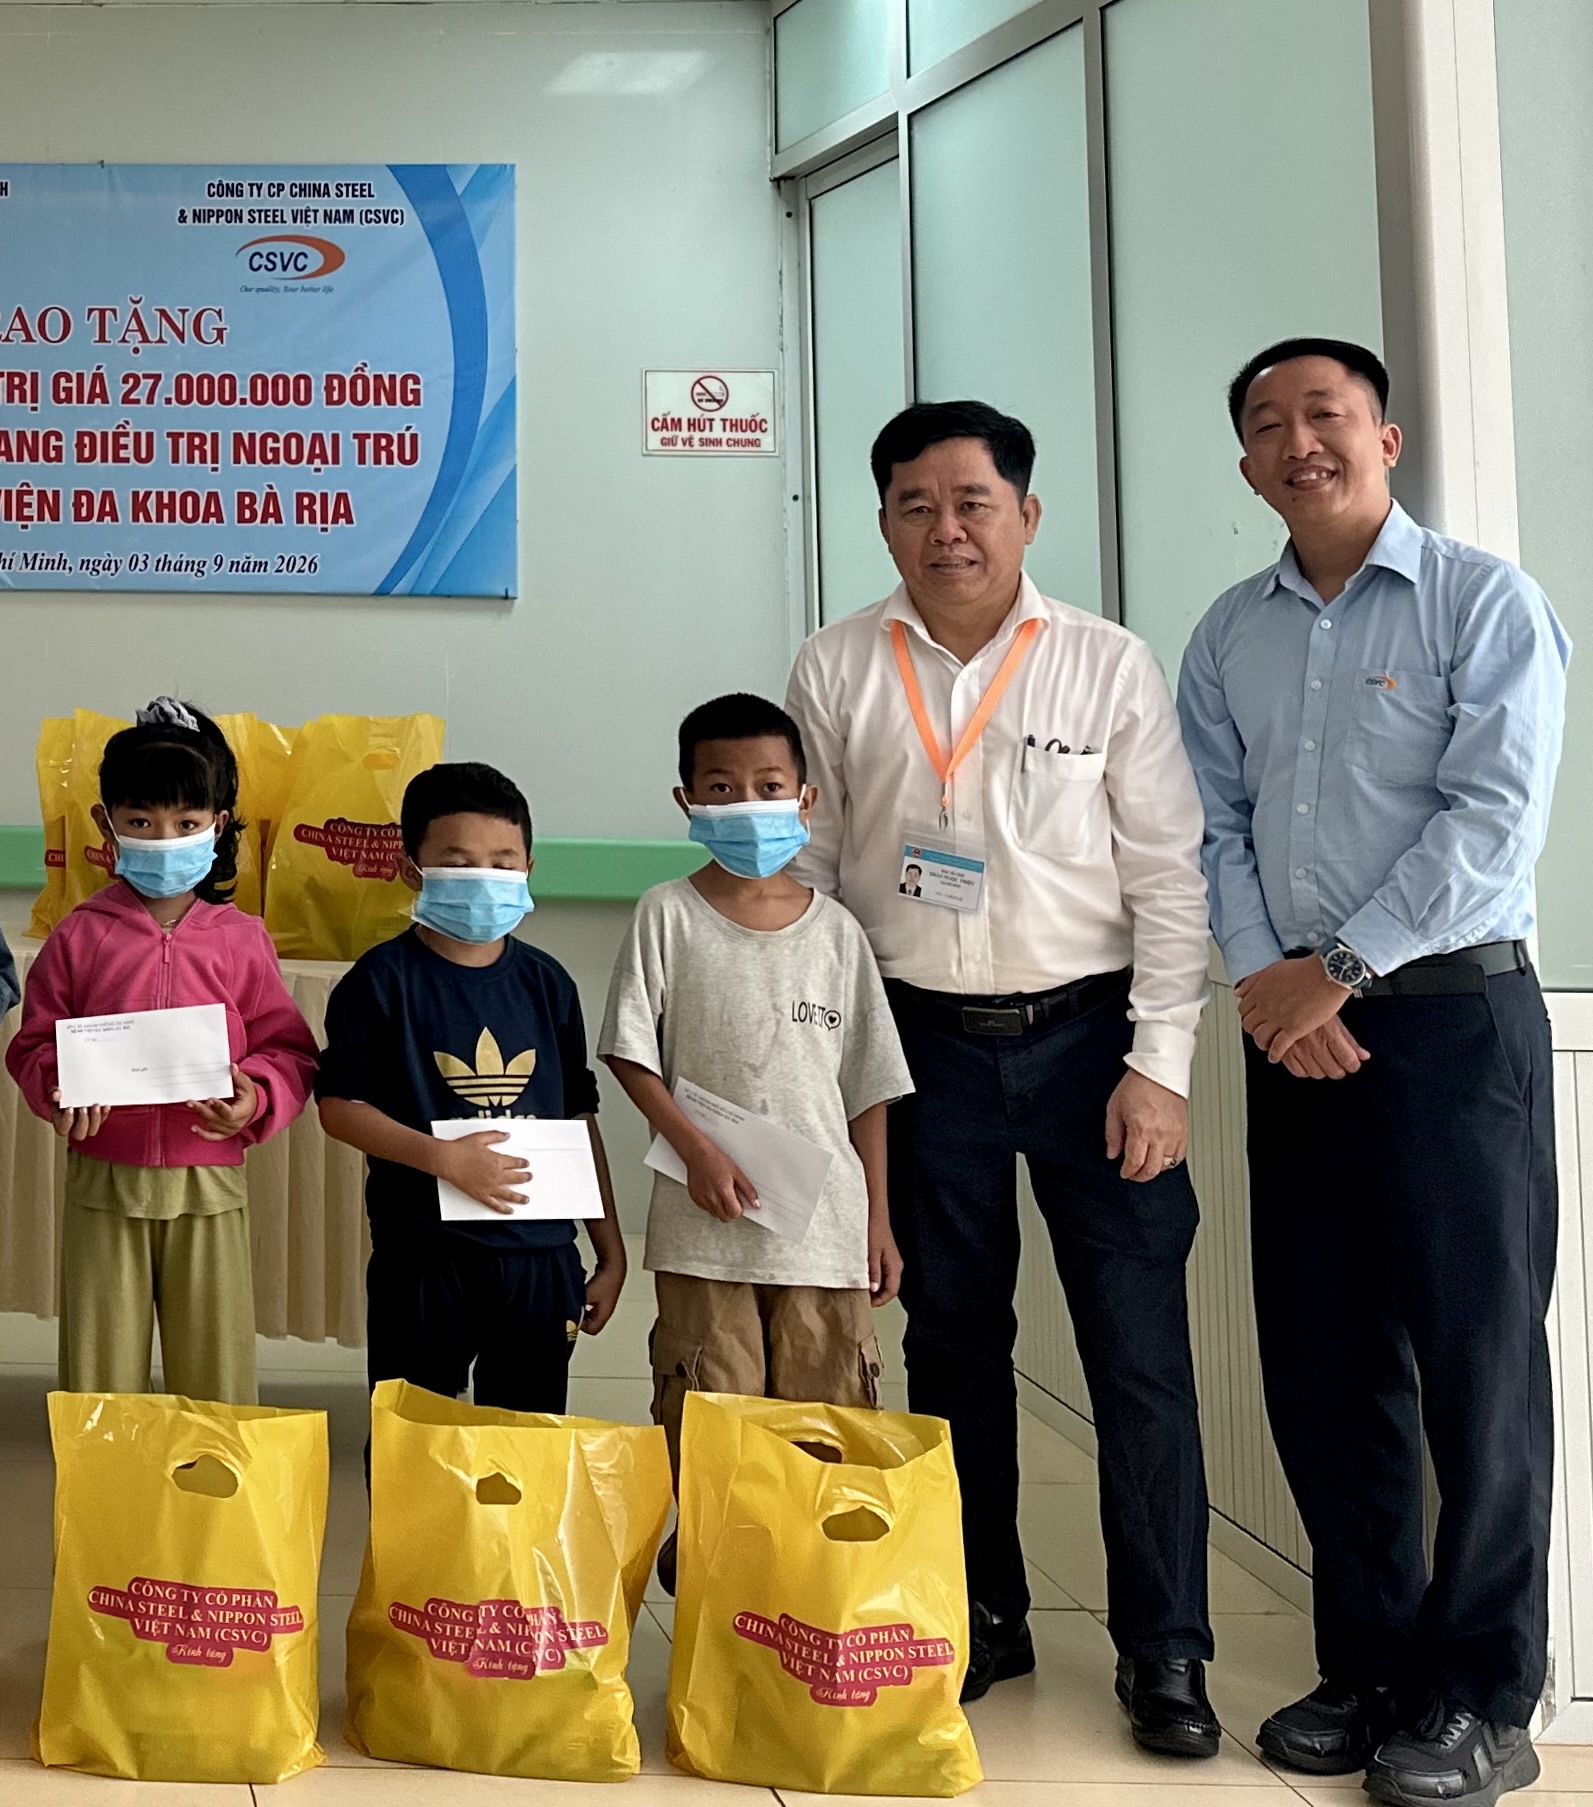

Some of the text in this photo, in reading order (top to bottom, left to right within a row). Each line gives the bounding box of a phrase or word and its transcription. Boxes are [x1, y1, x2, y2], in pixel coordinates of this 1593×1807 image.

[207, 179, 375, 198] CÔNG TY CP CHINA STEEL
[178, 206, 405, 227] & NIPPON STEEL VIỆT NAM (CSVC)
[248, 251, 309, 272] CSVC
[87, 296, 228, 355] TẶNG
[52, 365, 110, 404] GIÁ
[121, 373, 313, 405] 27.000.000
[323, 361, 421, 406] ĐỒNG
[651, 411, 768, 433] CẤM HÚT THUỐC
[75, 420, 154, 464] ĐIỀU
[166, 431, 220, 472] TRỊ
[232, 432, 340, 473] NGOẠI
[353, 425, 419, 465] TRÚ
[660, 435, 761, 448] GIỮ VỆ SINH CHUNG
[72, 490, 119, 523] ĐA
[131, 490, 224, 524] KHOA
[236, 484, 283, 524] BÀ
[295, 491, 354, 533] RỊA
[19, 552, 73, 574] Minh,
[79, 553, 122, 577] ngày
[128, 554, 149, 573] 03
[154, 554, 207, 577] tháng
[213, 555, 223, 573] 9
[229, 555, 269, 573] năm
[274, 554, 319, 574] 2026
[301, 827, 333, 843] CHINA
[335, 835, 370, 849] STEEL
[371, 840, 380, 849] &
[329, 821, 379, 837] CÔNG TY
[360, 850, 384, 861] NAM
[131, 1580, 203, 1603] CÔNG TY
[88, 1590, 303, 1627] CHINA STEEL & NIPPON STEEL
[427, 1602, 499, 1622] CÔNG TY
[134, 1618, 268, 1645] VIỆT NAM (CSVC)
[389, 1606, 431, 1632] CHINA
[489, 1621, 502, 1634] &
[558, 1625, 607, 1643] STEEL
[781, 1617, 844, 1651] CÔNG TY
[430, 1637, 469, 1656] VIỆT
[474, 1639, 511, 1653] NAM
[734, 1615, 954, 1667] CHINA STEEL & NIPPON STEEL
[781, 1652, 908, 1683] VIỆT NAM (CSVC)
